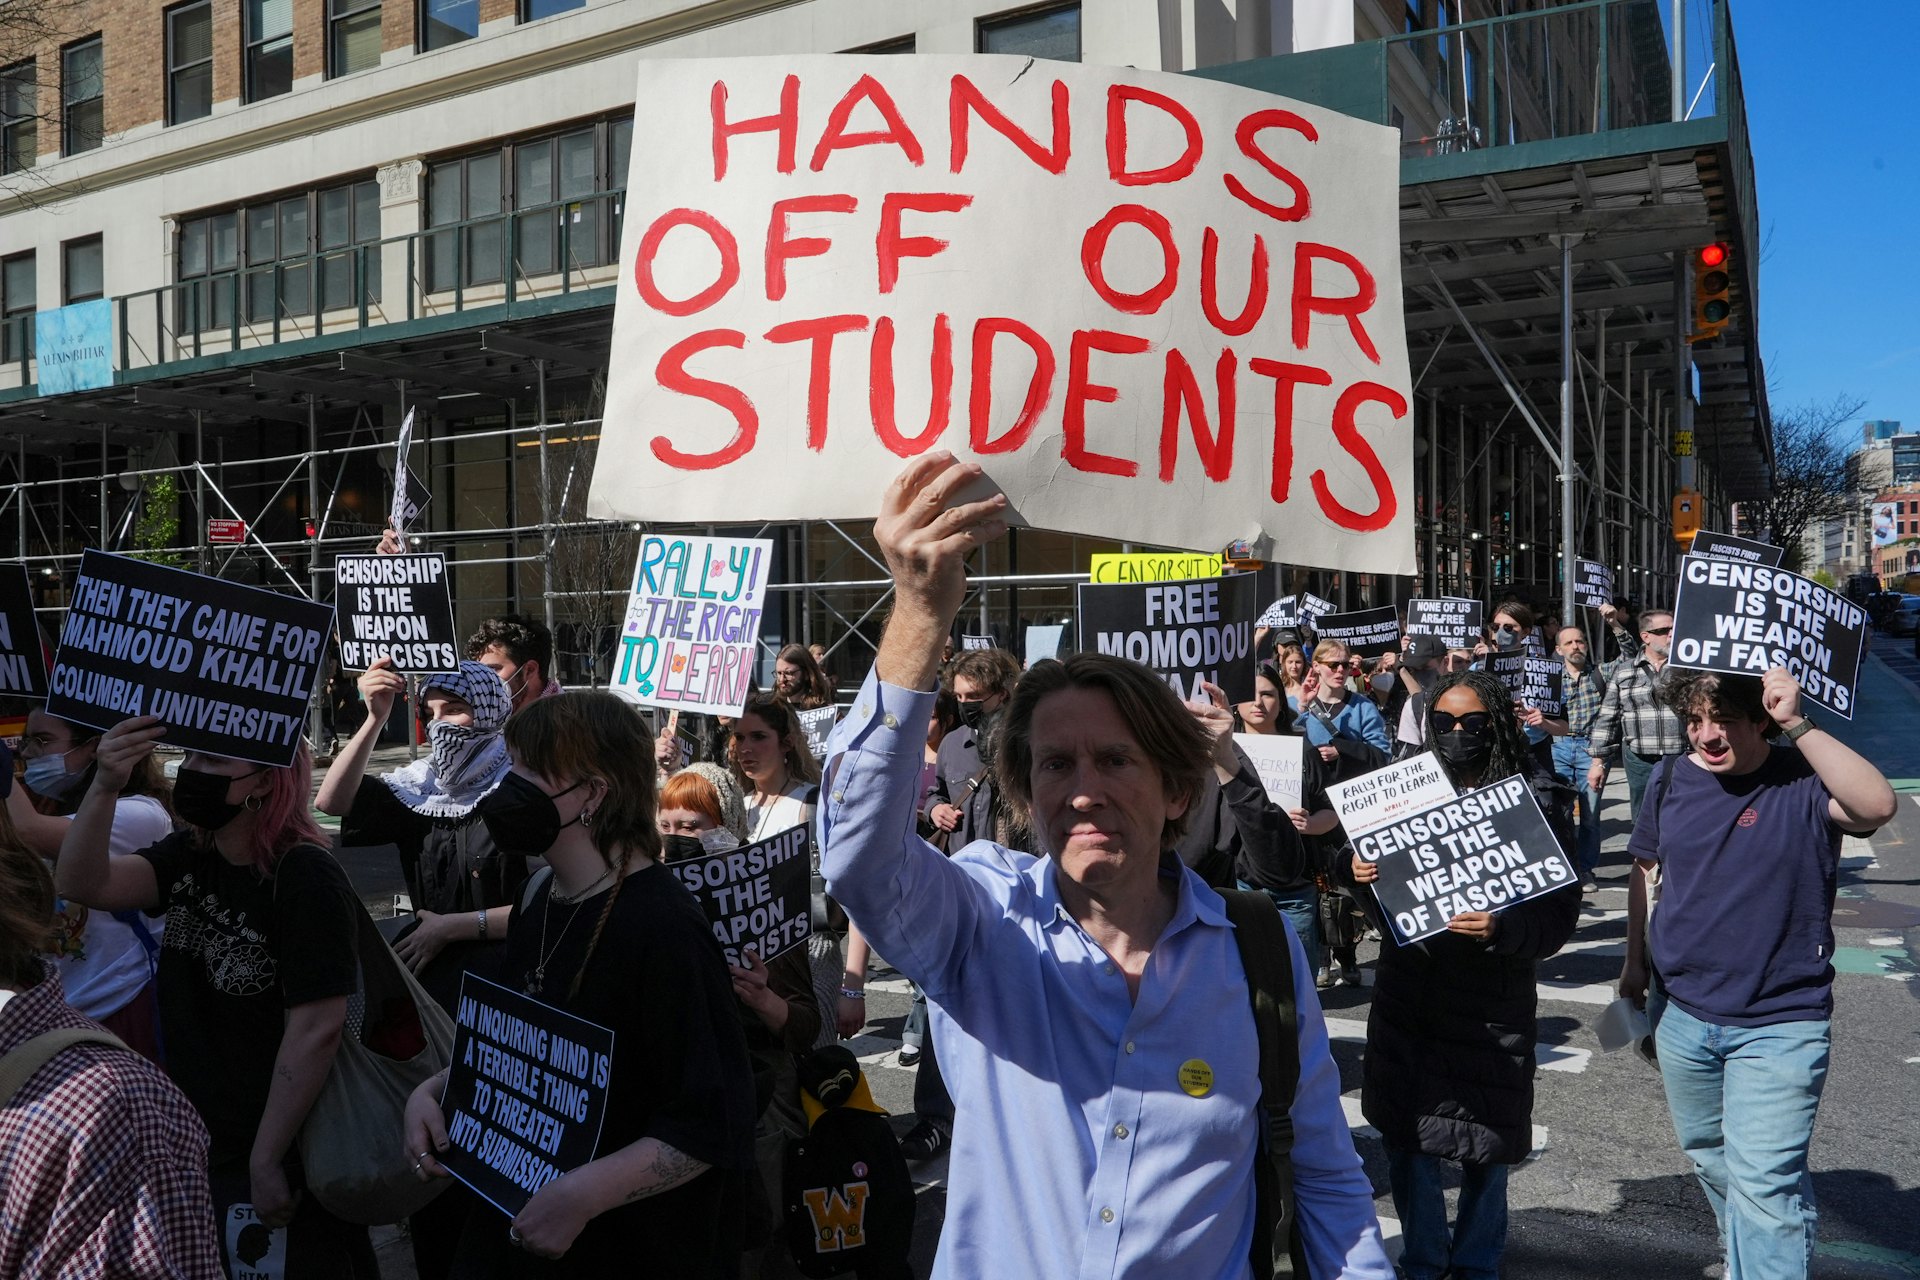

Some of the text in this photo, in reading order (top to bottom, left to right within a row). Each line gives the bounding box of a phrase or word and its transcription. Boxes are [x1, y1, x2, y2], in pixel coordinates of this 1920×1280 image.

[711, 73, 1318, 222] HANDS
[634, 193, 1380, 364] OFF OUR
[43, 352, 71, 366] ALEXIS
[650, 312, 1408, 533] STUDENTS
[337, 557, 443, 584] CENSORSHIP
[636, 537, 762, 602] RALLY!
[1584, 562, 1602, 574] NONE
[1710, 543, 1740, 555] FASCISTS
[1740, 549, 1761, 561] FIRST
[358, 587, 413, 613] IS THE
[1575, 583, 1597, 594] UNTIL
[1586, 596, 1602, 606] ARE
[1588, 574, 1602, 584] ARE
[1687, 561, 1862, 630] CENSORSHIP
[75, 575, 321, 664] THEN THEY CAME FOR
[647, 597, 696, 640] THE
[697, 602, 761, 643] RIGHT
[1145, 583, 1220, 626] FREE
[1322, 602, 1330, 611] US
[1417, 601, 1471, 613] NONE OF US
[1421, 613, 1465, 624] ARE FREE
[1735, 591, 1827, 640] IS THE
[352, 615, 429, 641] WEAPON
[1097, 621, 1249, 669] MOMODOU
[1317, 620, 1399, 637] TO PROTECT FREE SPEECH
[1350, 636, 1367, 646] FREE
[1367, 631, 1398, 645] THOUGHT
[1407, 624, 1481, 637] UNTIL ALL OF US
[1715, 614, 1832, 673] WEAPON
[63, 613, 309, 700] MAHMOUD KHALIL
[343, 641, 456, 669] OF FASCISTS
[618, 635, 659, 685] TO
[1524, 660, 1562, 674] ORSHIP
[1677, 638, 1849, 711] OF FASCISTS
[1526, 672, 1548, 685] THE
[53, 663, 301, 746] COLUMBIA UNIVERSITY
[800, 707, 835, 724] RSHIP
[1521, 698, 1560, 713] ASCISTS
[1260, 776, 1300, 794] TUDENTS
[1342, 771, 1440, 815] RIGHT TO LEARN!
[1343, 761, 1426, 799] RALLY FOR THE
[1359, 780, 1524, 861] CENSORSHIP
[1384, 802, 1402, 813] APRIL
[672, 827, 806, 892] SORSHIP
[1409, 843, 1440, 873] IS
[1440, 820, 1501, 860] THE
[1406, 839, 1527, 902] WEAPON
[712, 874, 772, 915] THE
[1395, 856, 1567, 937] OF FASCISTS
[712, 896, 785, 945] APON
[723, 911, 808, 970] SCISTS
[458, 996, 608, 1089] AN INQUIRING MIND IS
[464, 1037, 589, 1124] A TERRIBLE THING
[450, 1109, 482, 1153] INTO
[472, 1079, 565, 1156] TO THREATEN
[803, 1181, 870, 1253] W
